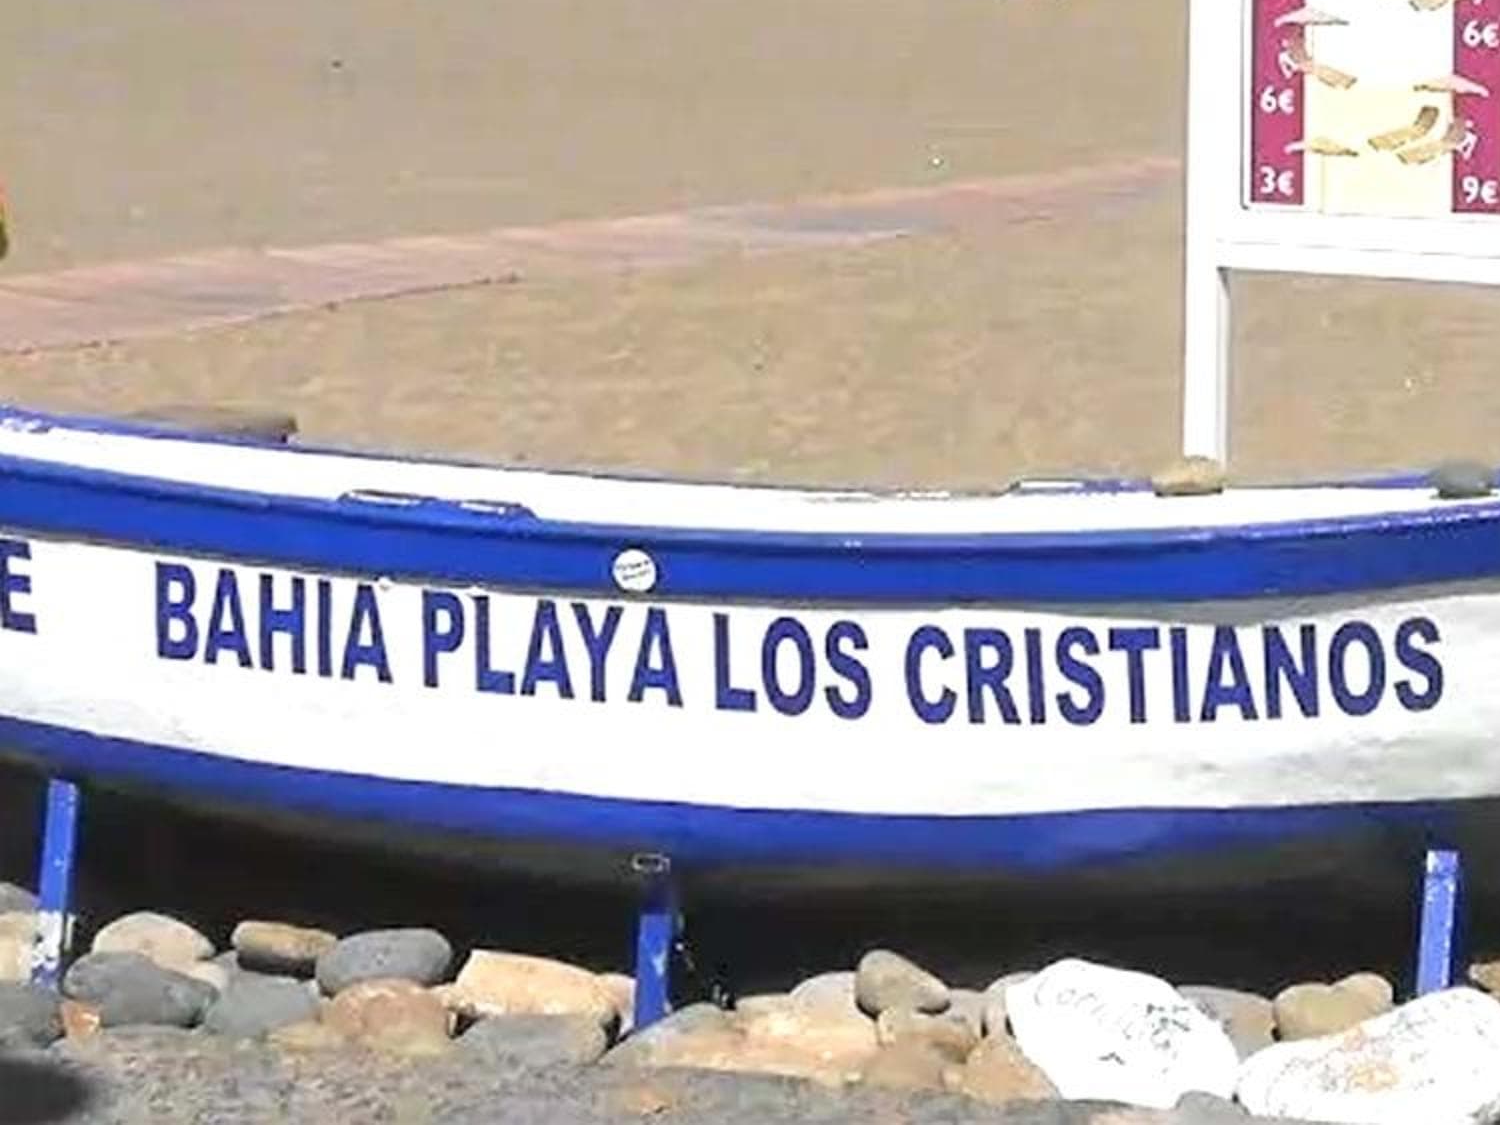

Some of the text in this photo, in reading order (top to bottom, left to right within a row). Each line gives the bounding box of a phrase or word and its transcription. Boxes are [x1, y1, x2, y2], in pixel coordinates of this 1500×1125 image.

[1462, 20, 1500, 48] 6€
[1259, 85, 1294, 113] 6€
[1260, 166, 1294, 196] 3€
[1462, 175, 1498, 205] 9€
[155, 560, 394, 684] BAHIA
[421, 589, 684, 709] PLAYA
[713, 612, 873, 720] LOS
[904, 616, 1444, 726] CRISTIANOS
